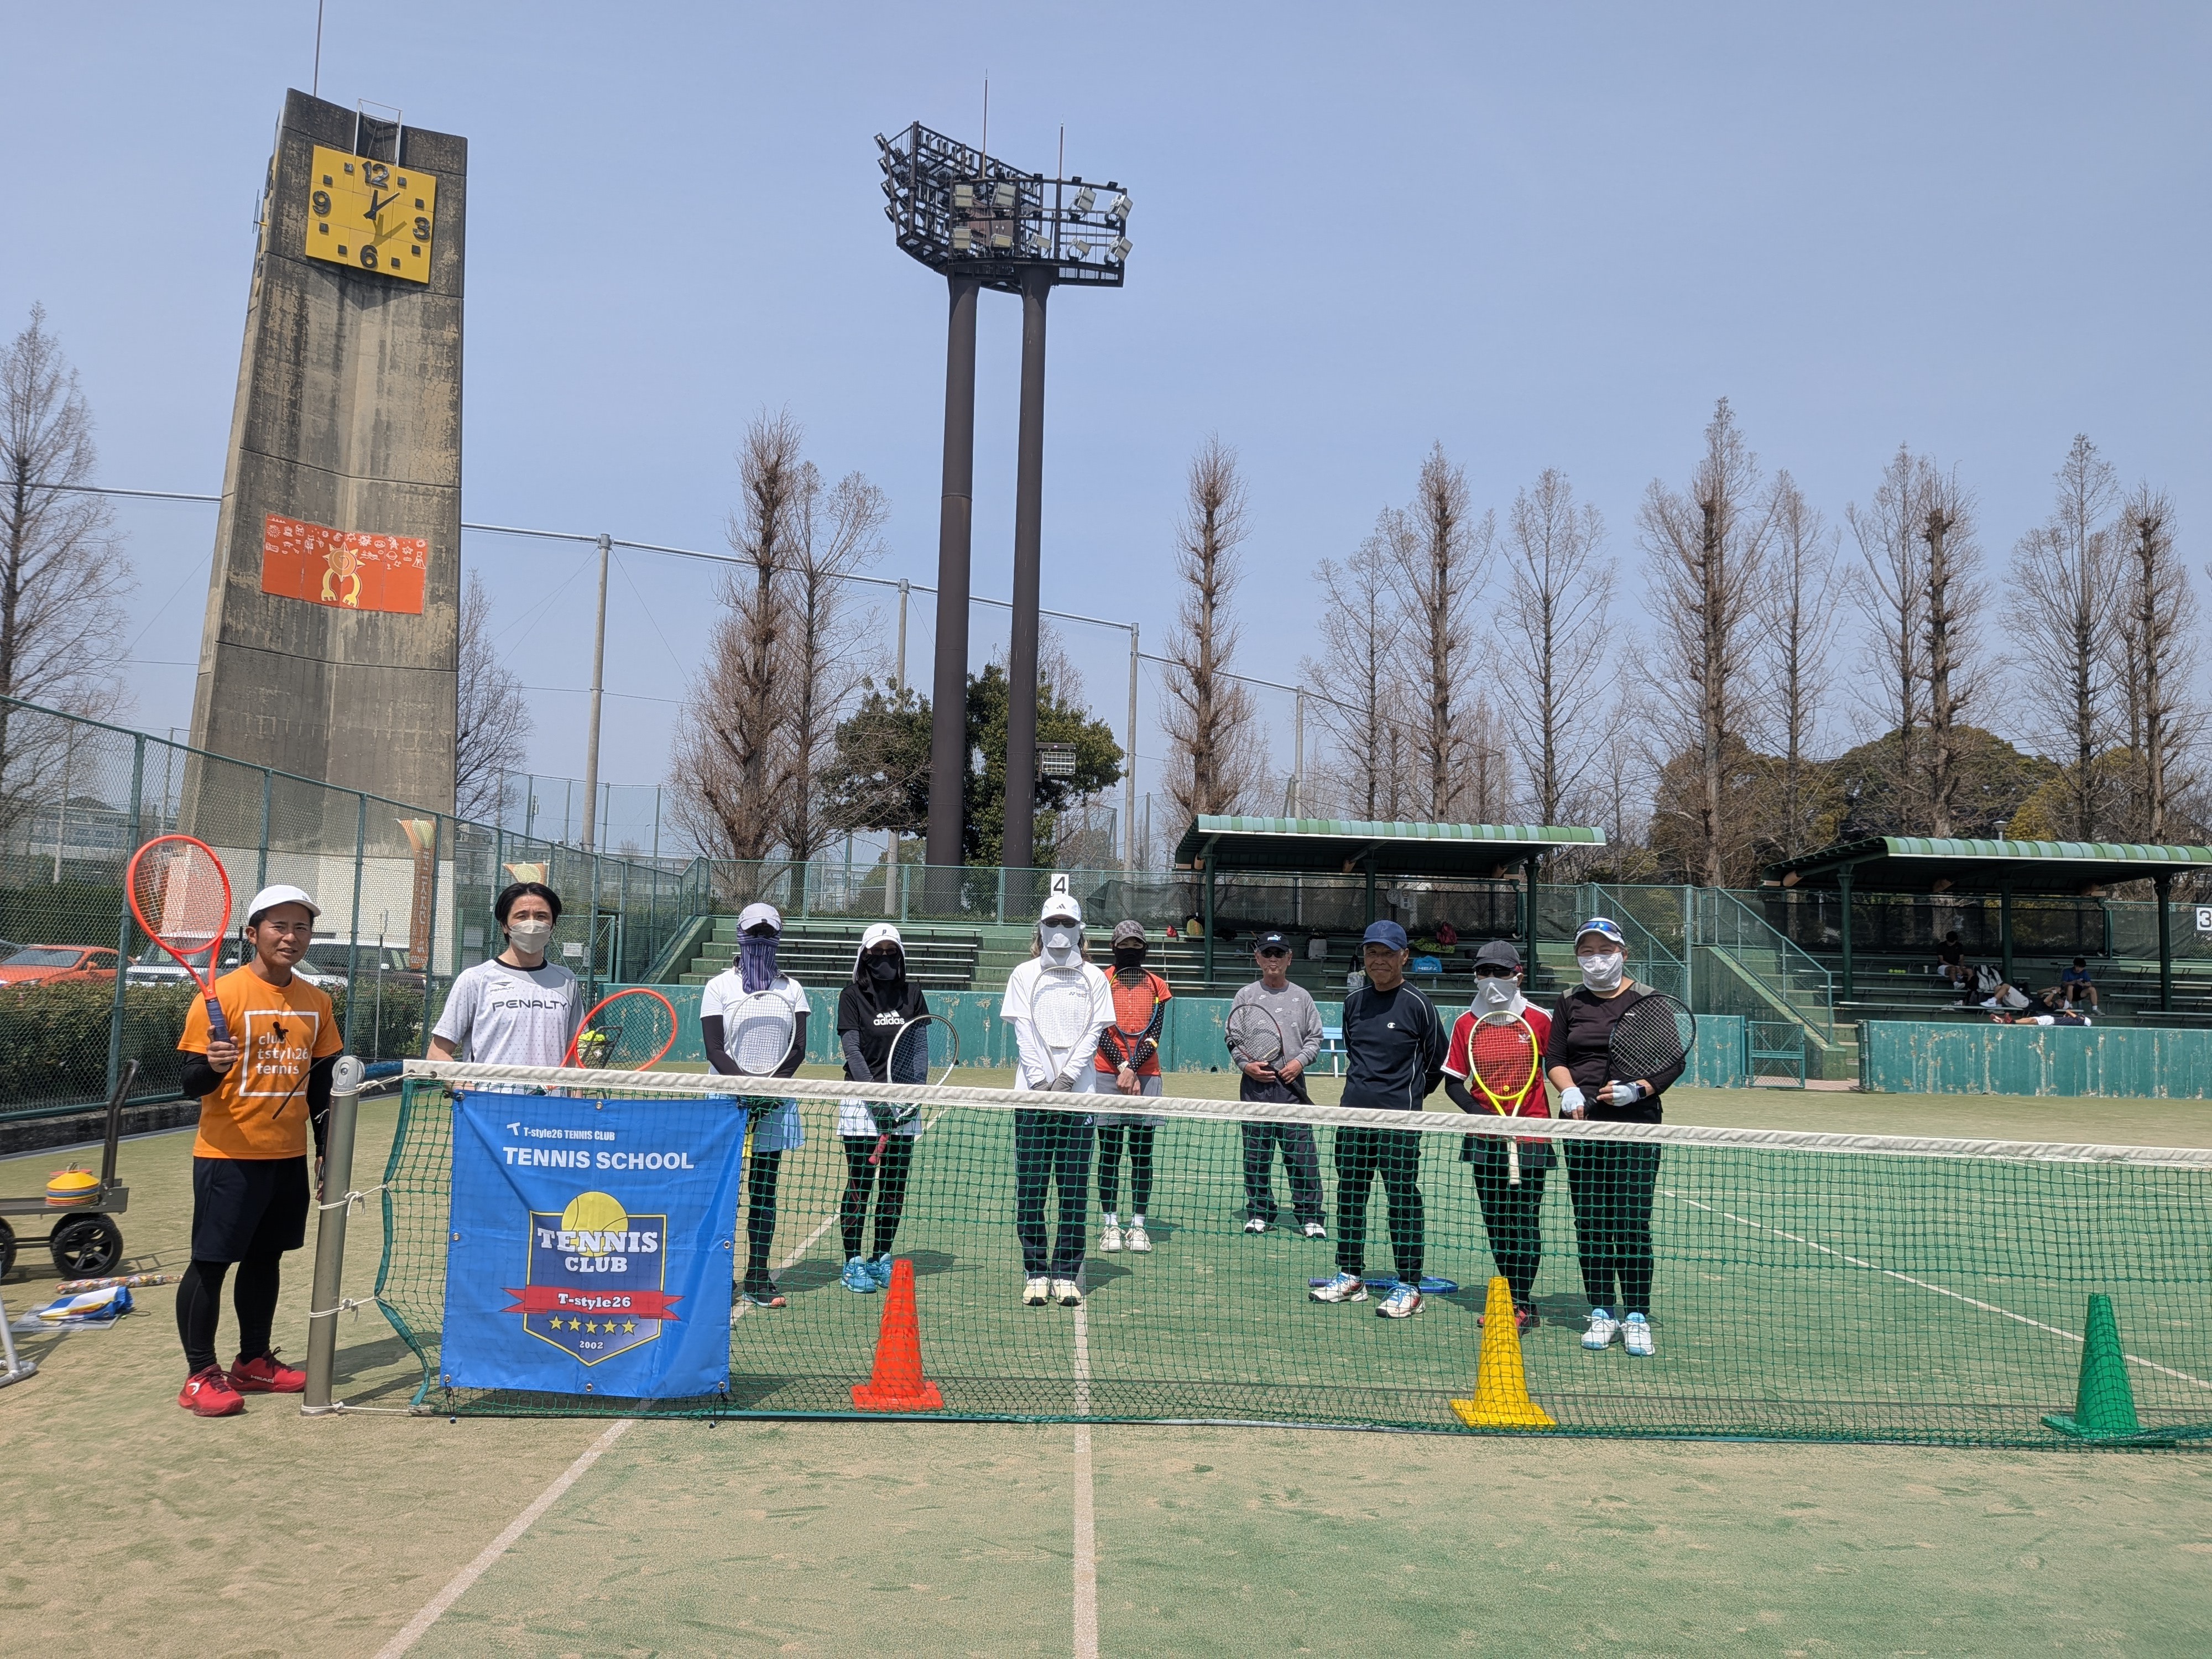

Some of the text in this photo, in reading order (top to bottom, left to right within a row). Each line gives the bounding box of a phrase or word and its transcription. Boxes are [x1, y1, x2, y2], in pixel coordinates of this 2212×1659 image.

[362, 161, 389, 188] 12
[312, 190, 332, 214] 9
[413, 217, 431, 239] 3
[360, 245, 378, 268] 6
[1053, 877, 1066, 894] 4
[2199, 910, 2212, 928] 3
[492, 999, 567, 1013] PENALTY
[874, 1016, 905, 1026] adidas
[256, 1062, 299, 1074] tennis
[523, 1127, 563, 1139] T-style26
[564, 1130, 593, 1140] TENNIS
[594, 1131, 615, 1141] CLUB
[503, 1146, 695, 1170] TENNIS SCHOOL
[537, 1227, 659, 1253] TENNIS
[565, 1256, 628, 1273] CLUB
[558, 1293, 632, 1311] T-style26
[579, 1340, 604, 1350] 2002
